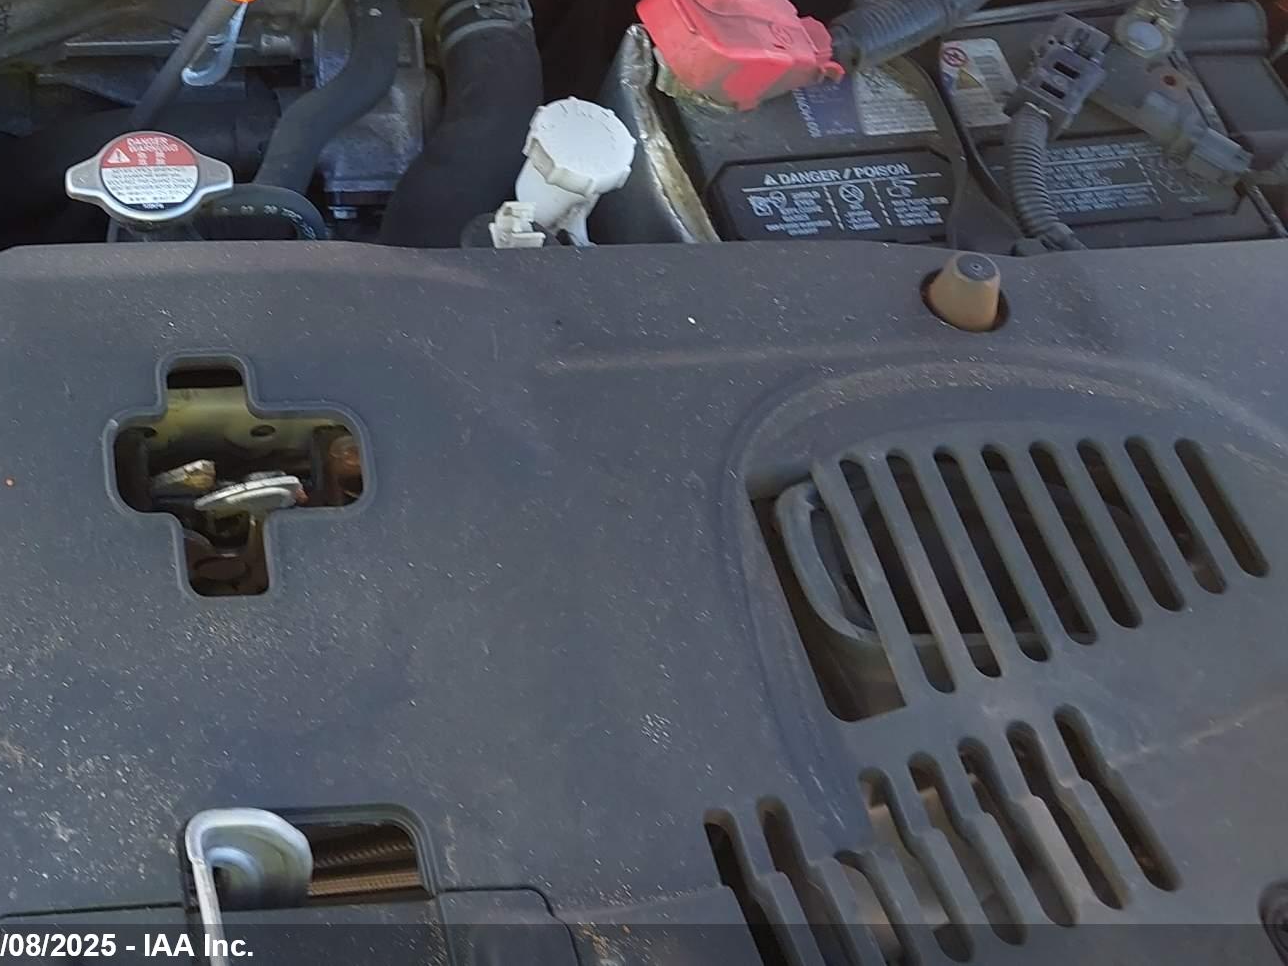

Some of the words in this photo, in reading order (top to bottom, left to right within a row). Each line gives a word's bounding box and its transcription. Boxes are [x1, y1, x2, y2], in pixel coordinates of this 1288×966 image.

[126, 137, 169, 147] DANGER
[777, 169, 842, 185] DANGER
[852, 162, 912, 178] POISON
